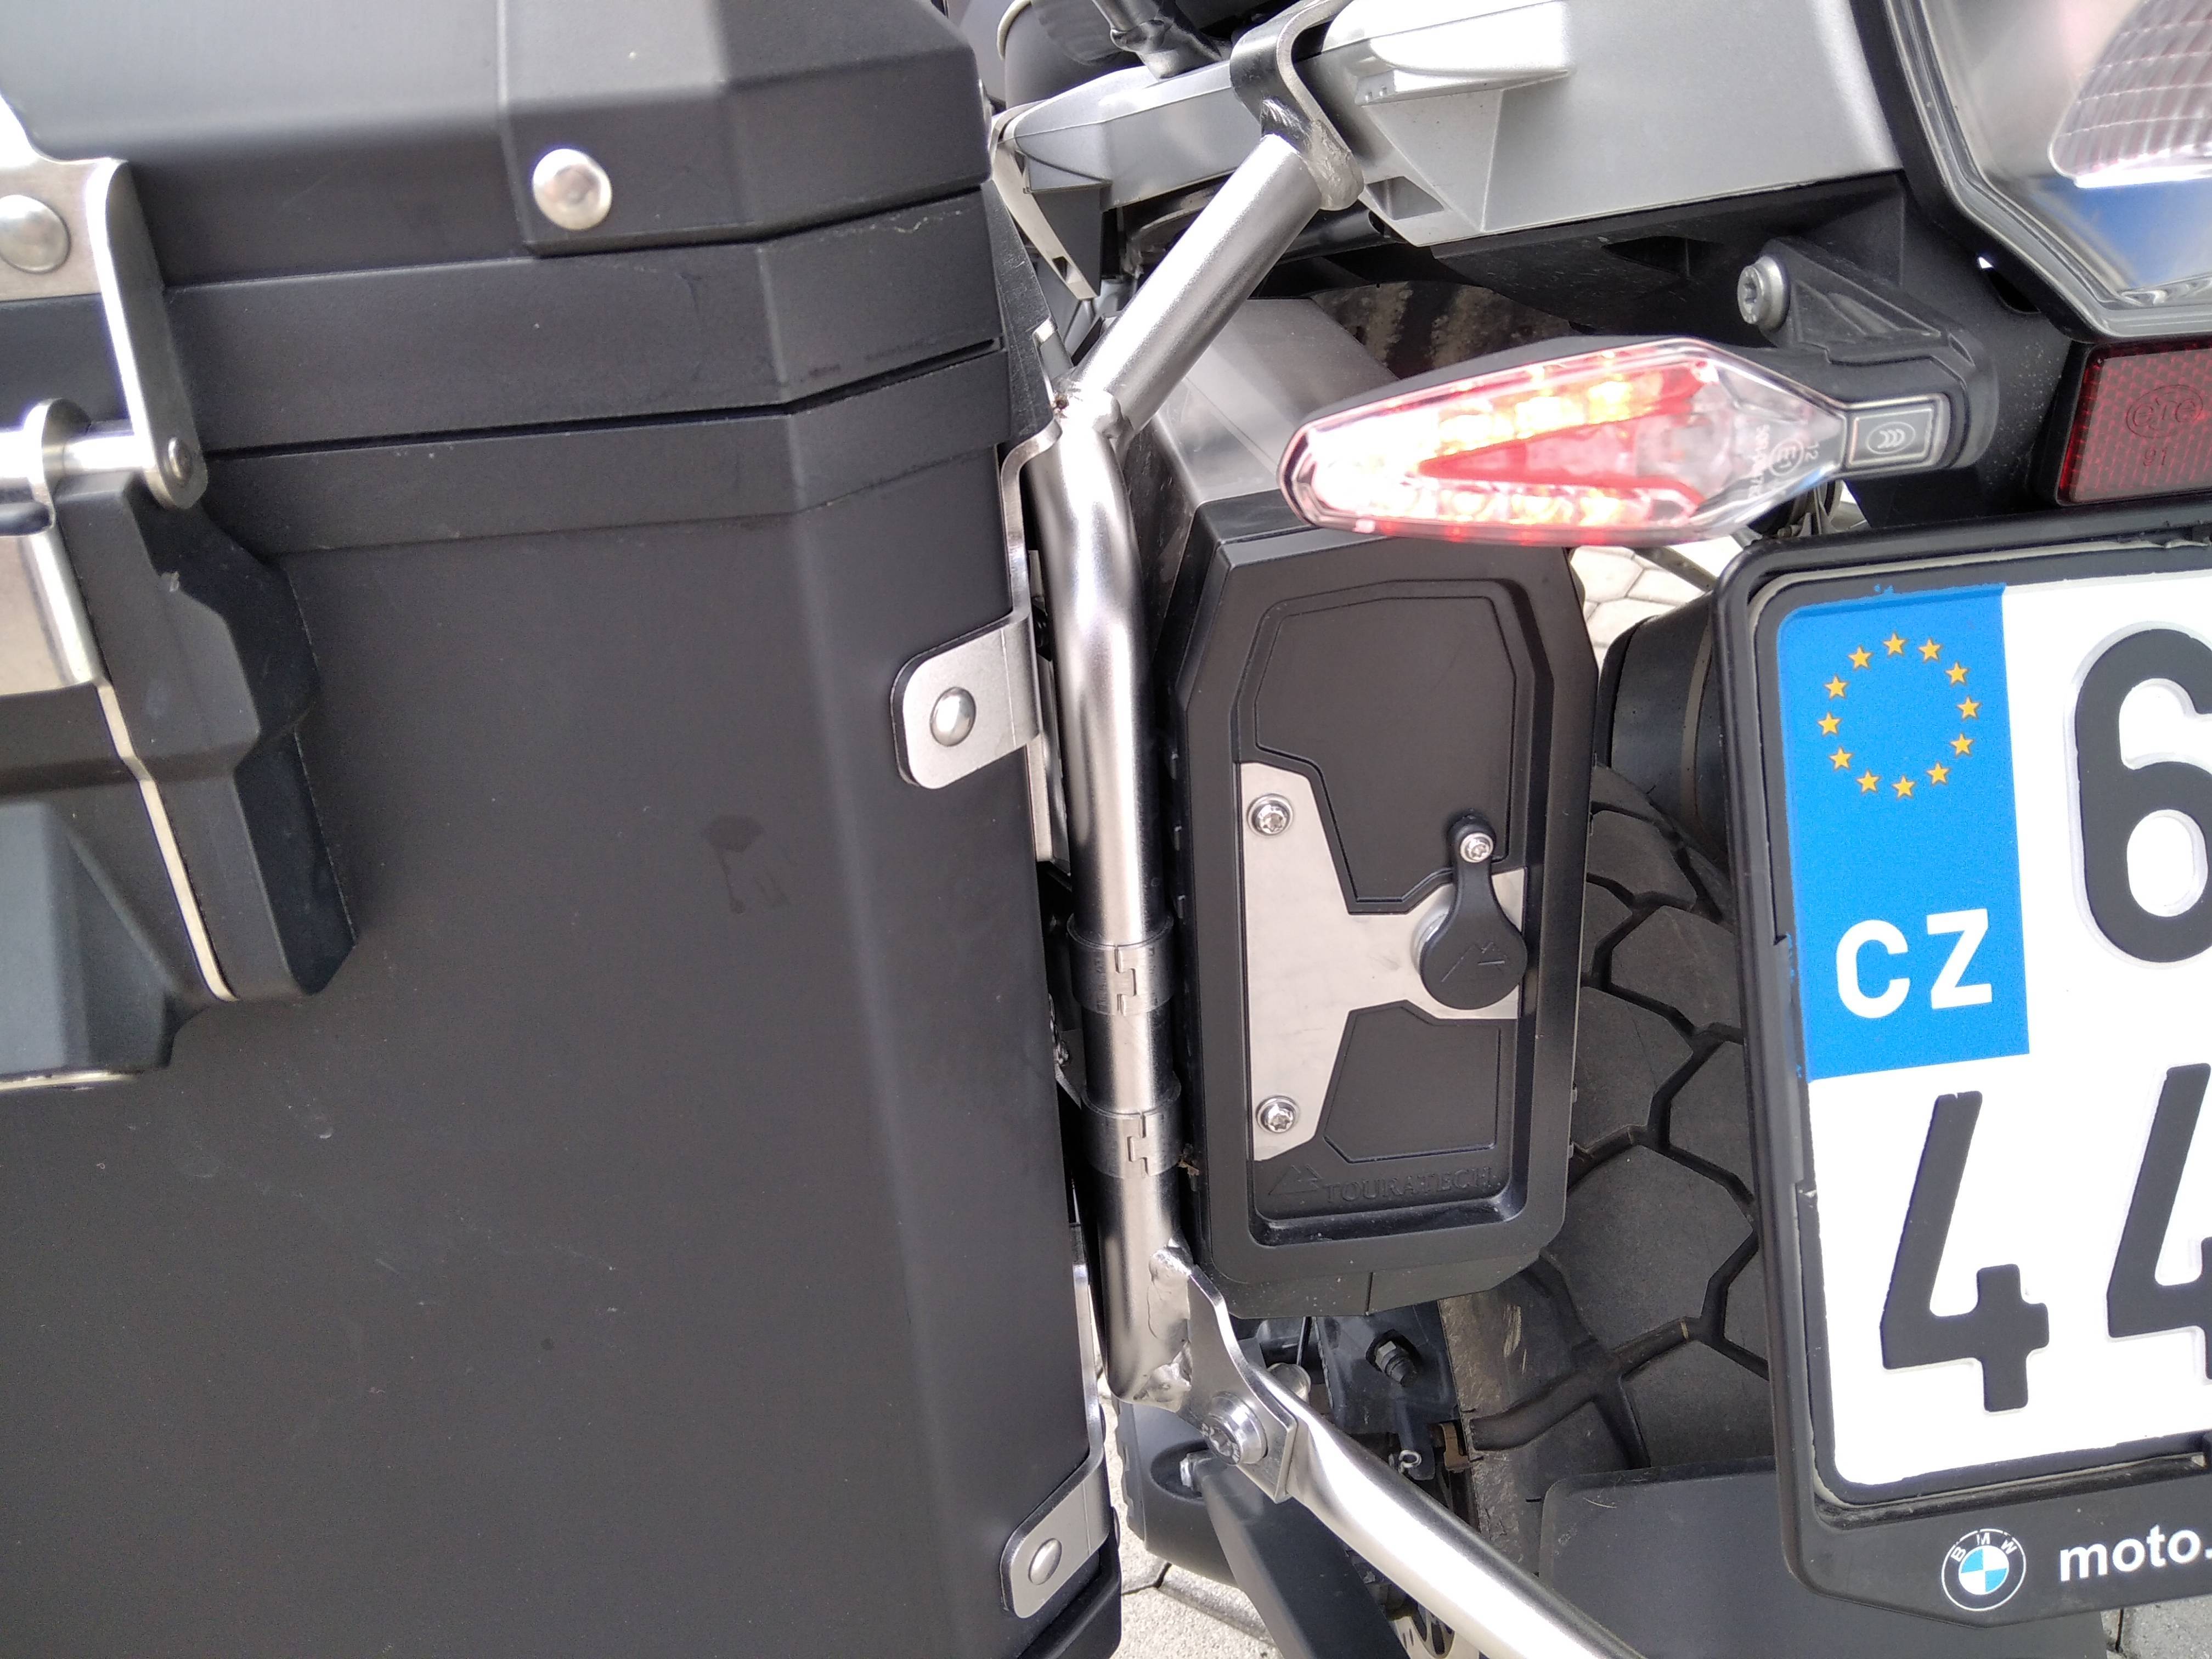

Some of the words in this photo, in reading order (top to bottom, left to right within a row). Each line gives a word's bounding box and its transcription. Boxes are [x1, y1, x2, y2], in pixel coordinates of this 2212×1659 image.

[2073, 628, 2212, 963] 6
[1836, 909, 1993, 1018] CZ
[1325, 1166, 1492, 1203] TOURATECH
[1950, 1532, 2017, 1562] BMW
